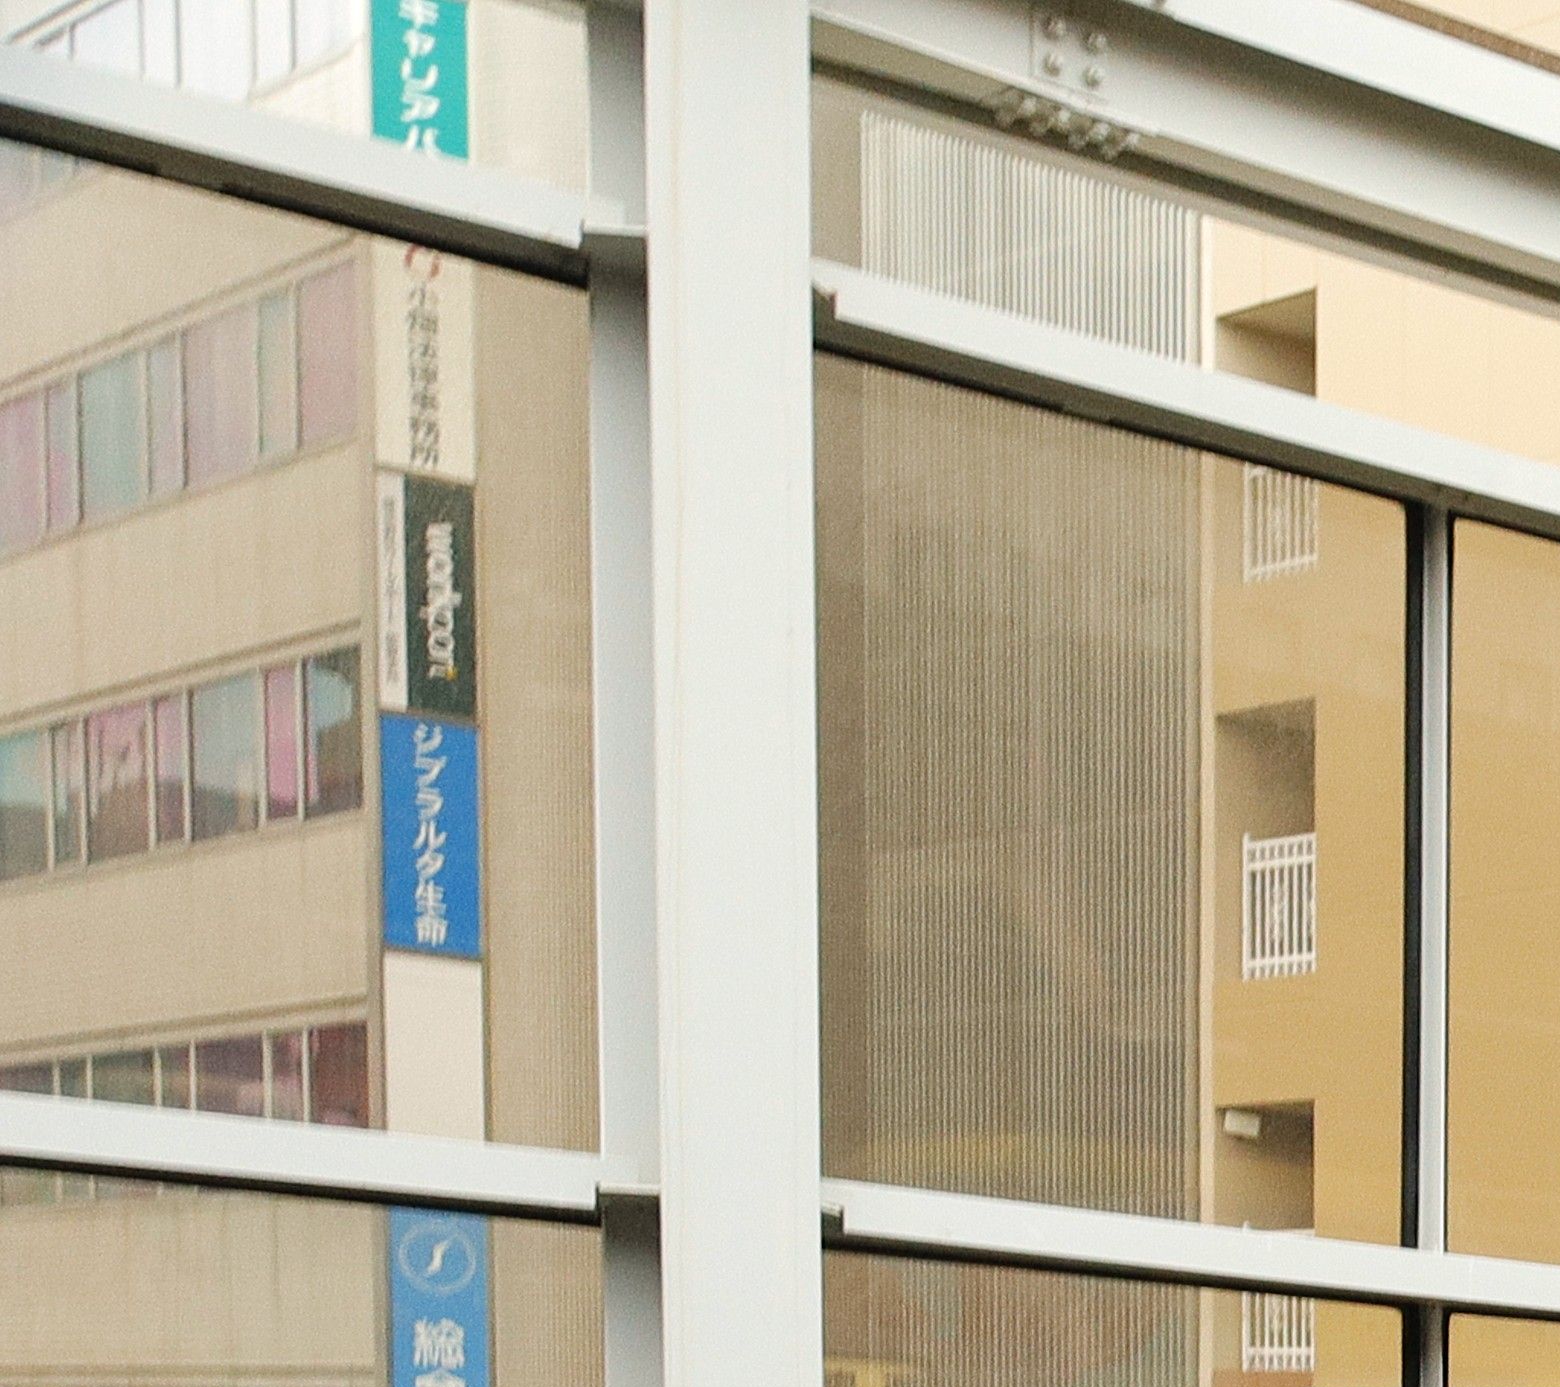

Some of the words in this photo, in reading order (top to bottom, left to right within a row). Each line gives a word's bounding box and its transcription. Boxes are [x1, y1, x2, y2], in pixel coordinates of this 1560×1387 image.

[412, 723, 448, 948] ジブラルタ生命
